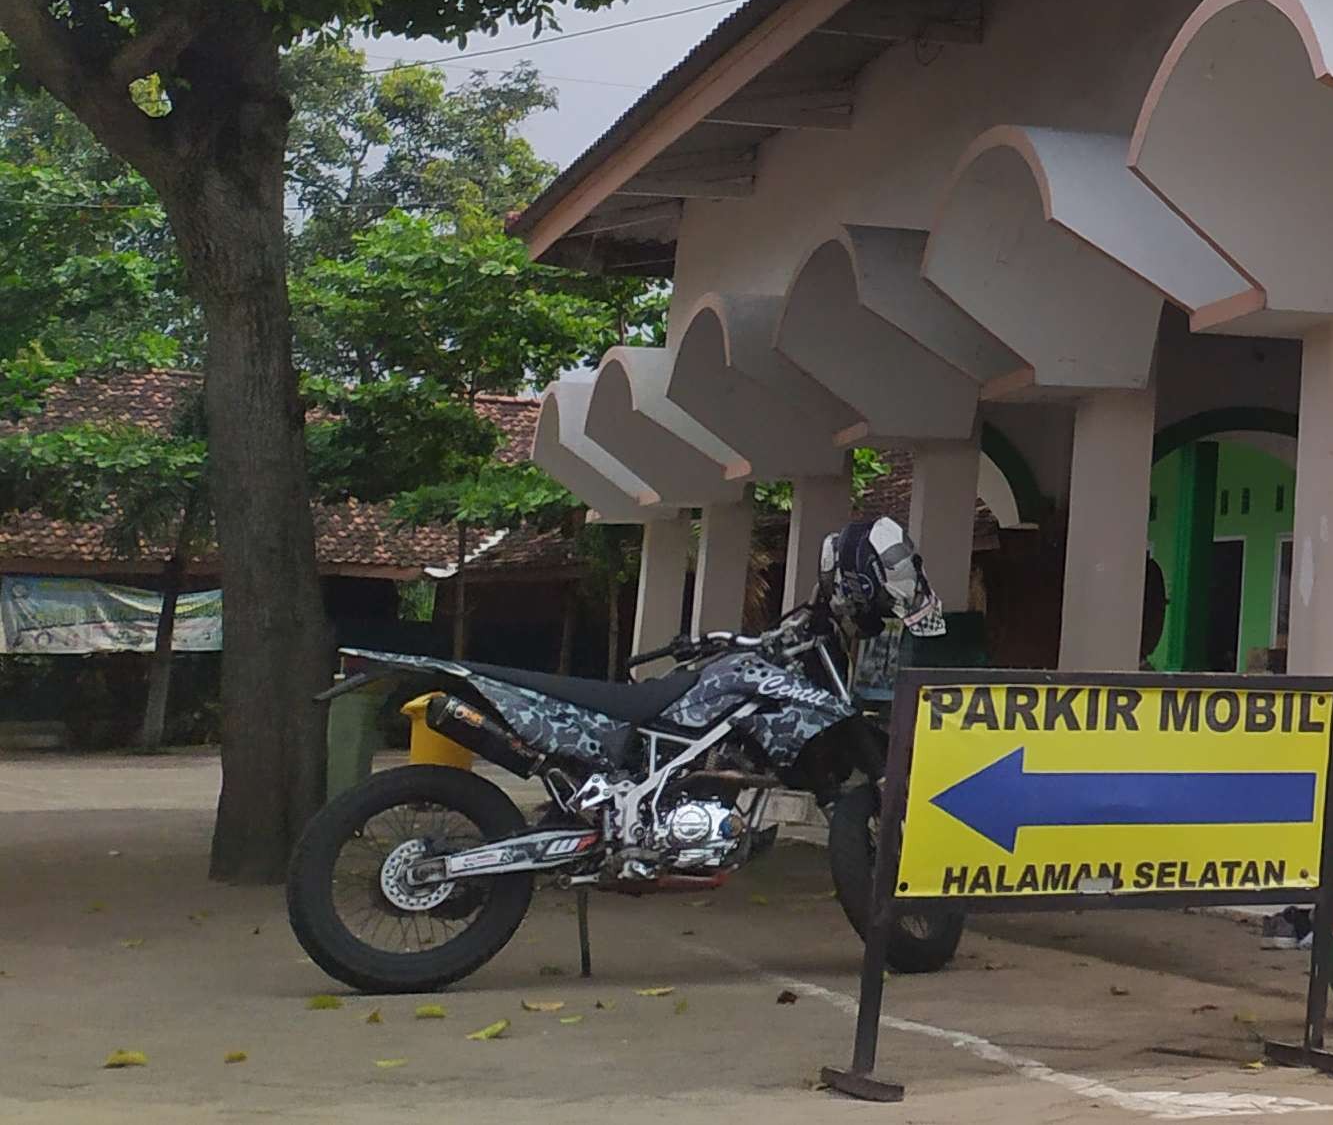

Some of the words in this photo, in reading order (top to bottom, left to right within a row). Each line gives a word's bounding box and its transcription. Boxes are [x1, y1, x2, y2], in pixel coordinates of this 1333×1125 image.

[928, 687, 1141, 732] PARKIR
[1159, 690, 1325, 734] MOBIL
[942, 863, 1124, 895] HALAMAN
[1132, 860, 1287, 889] SELATAN
